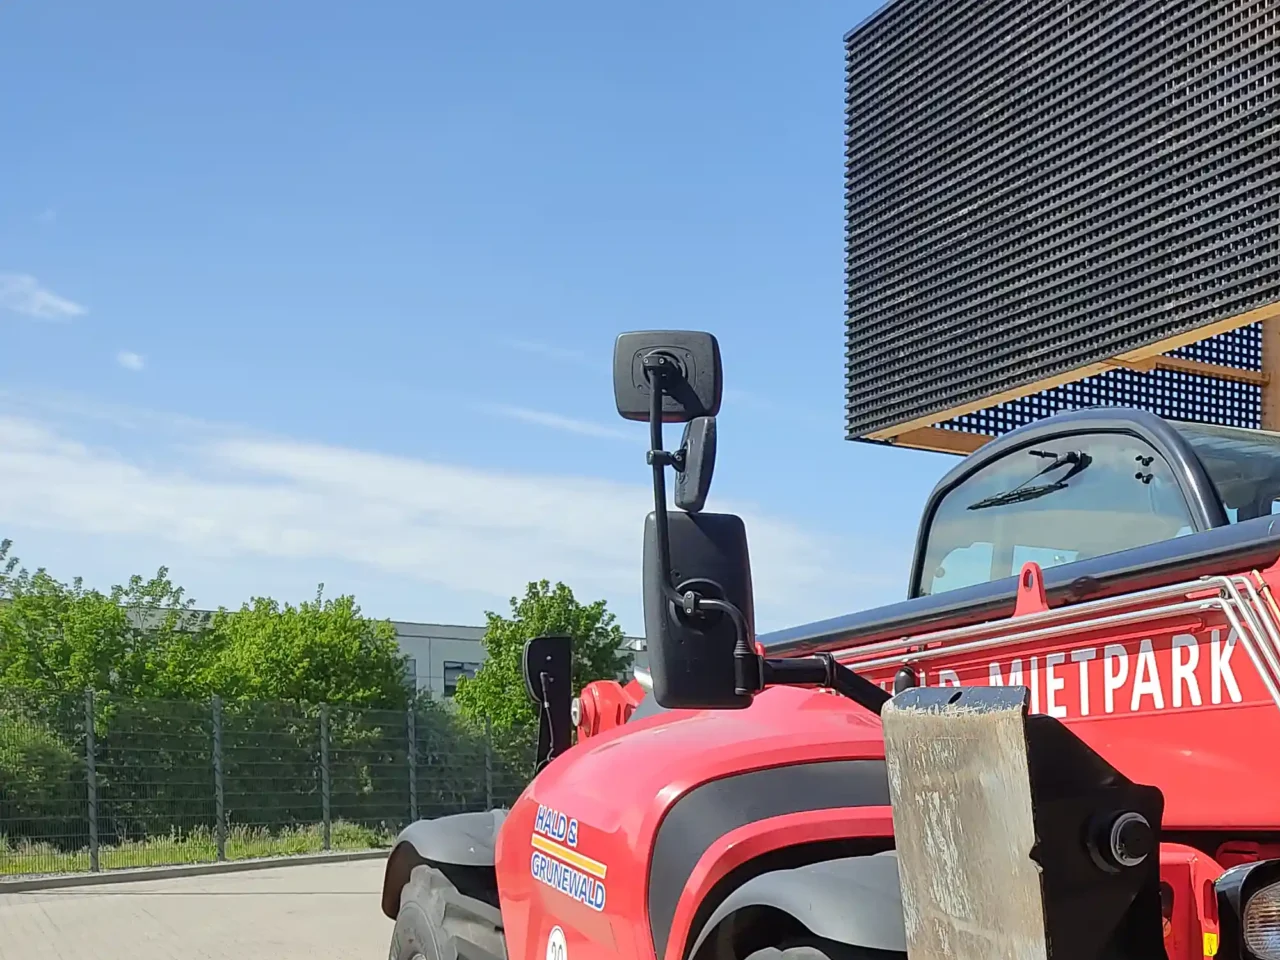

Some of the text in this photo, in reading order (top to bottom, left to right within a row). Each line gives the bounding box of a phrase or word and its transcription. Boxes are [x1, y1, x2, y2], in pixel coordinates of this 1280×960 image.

[535, 804, 578, 848] HALD &
[531, 851, 606, 912] GRUNEWALD
